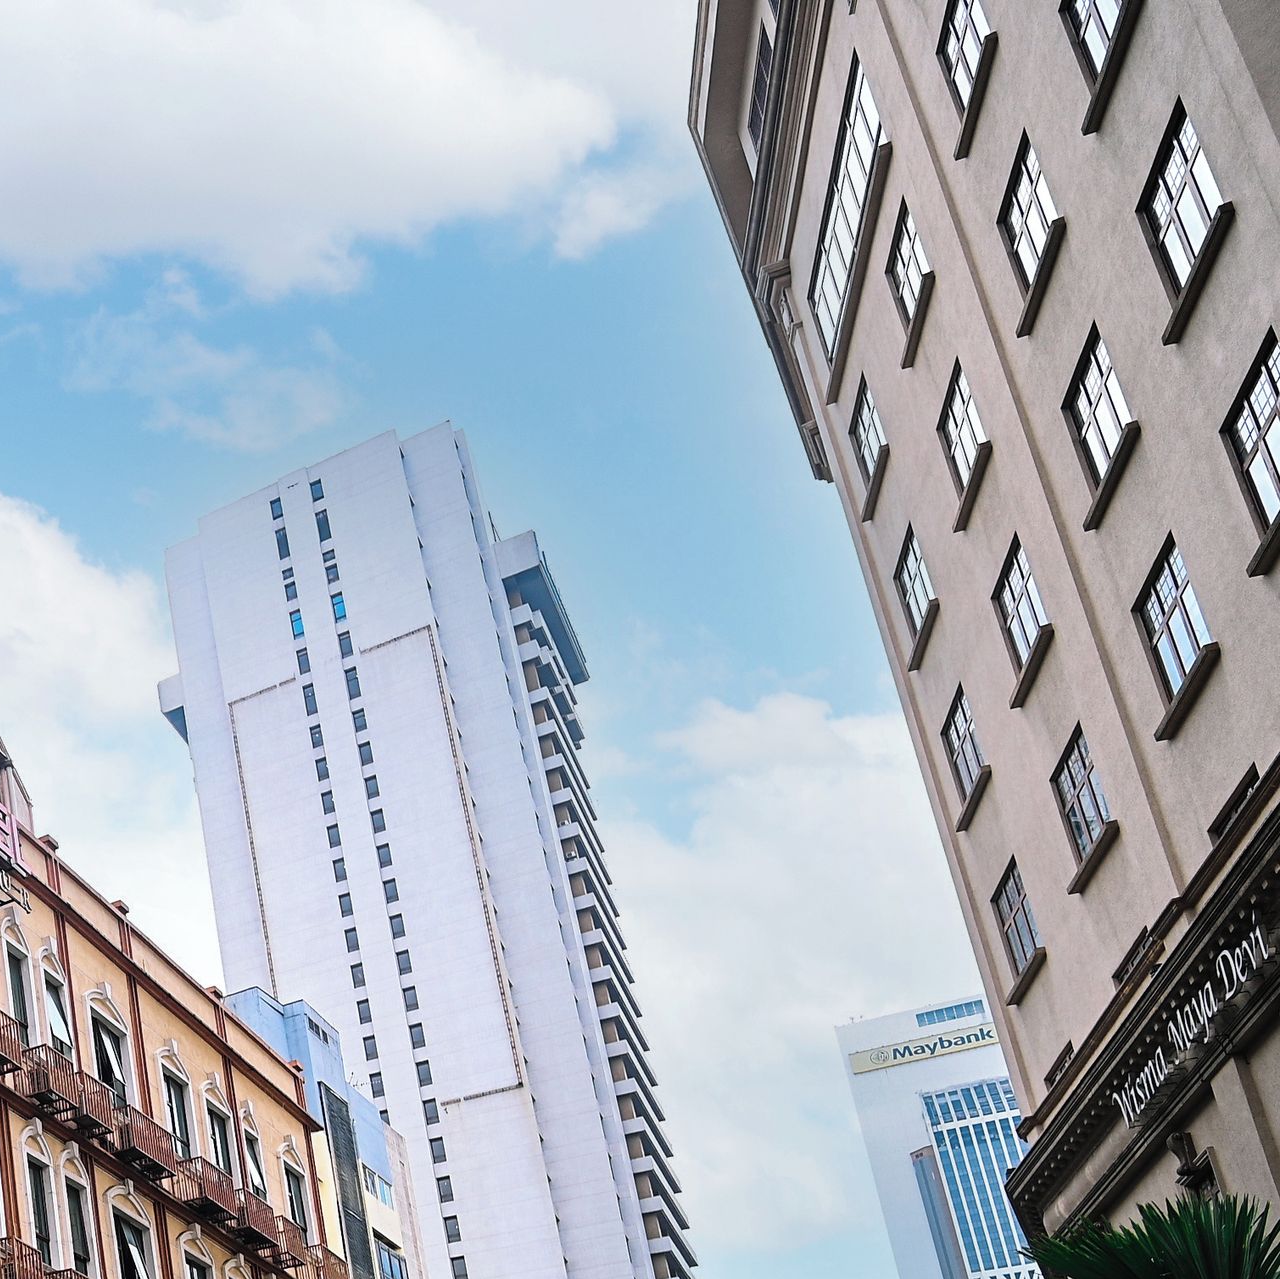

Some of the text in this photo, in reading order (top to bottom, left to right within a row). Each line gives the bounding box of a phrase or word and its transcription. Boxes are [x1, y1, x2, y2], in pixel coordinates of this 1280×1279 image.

[892, 1027, 995, 1060] Maybank
[1111, 908, 1270, 1130] Wisma Maya Devi
